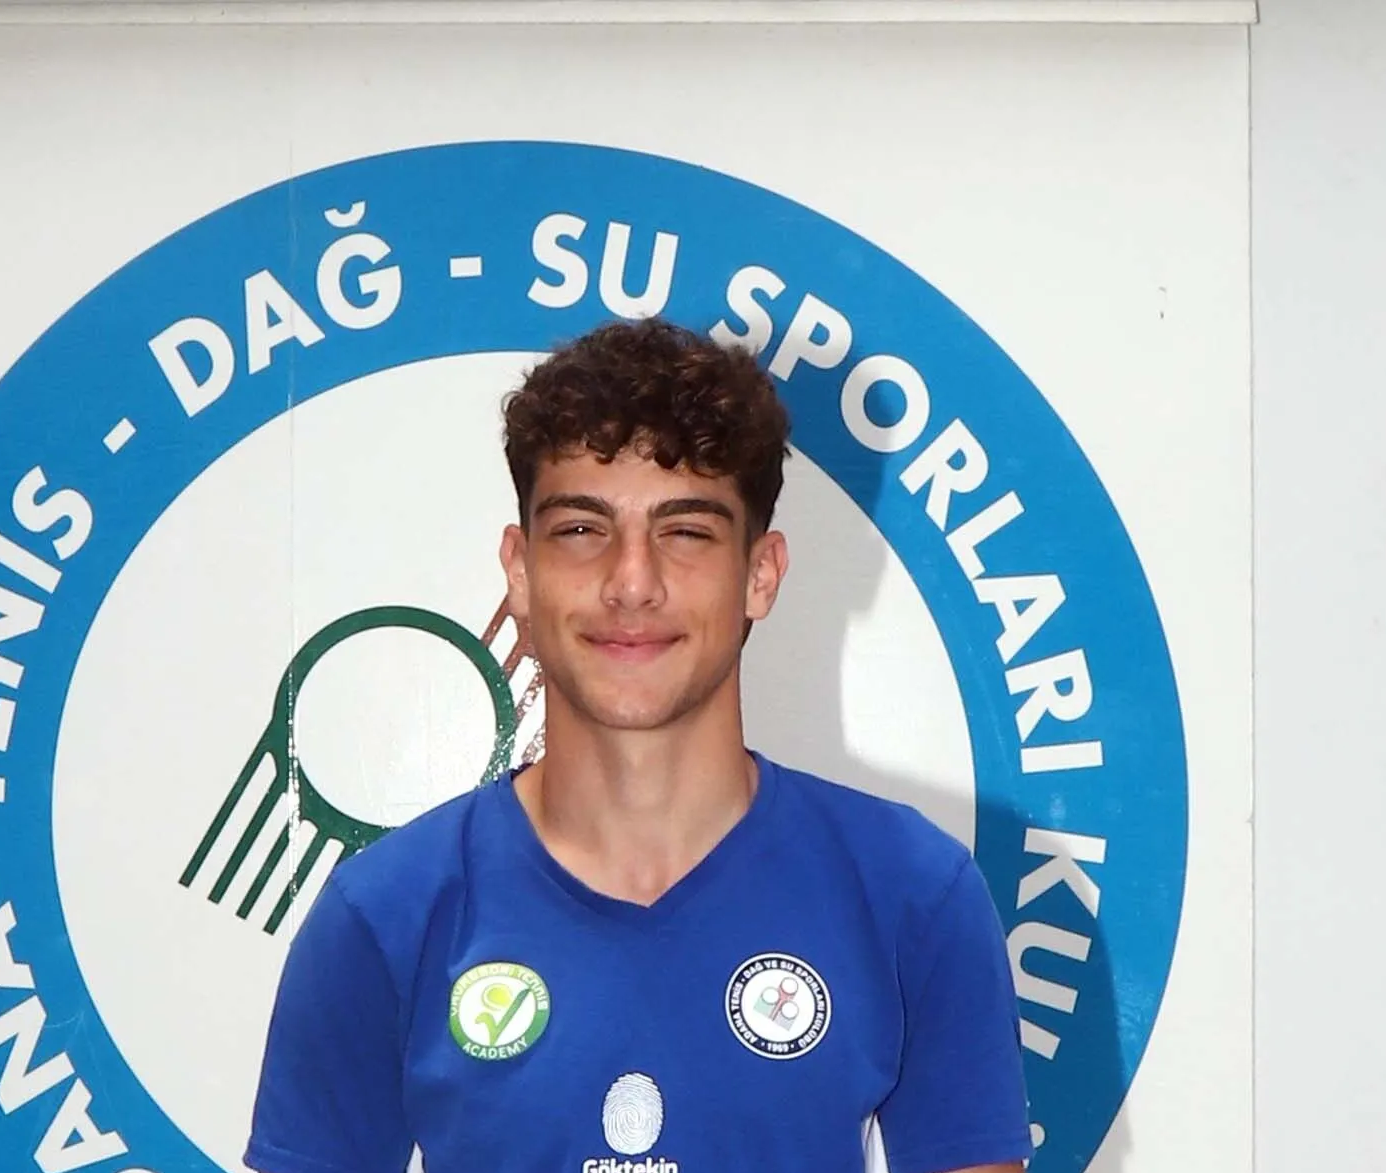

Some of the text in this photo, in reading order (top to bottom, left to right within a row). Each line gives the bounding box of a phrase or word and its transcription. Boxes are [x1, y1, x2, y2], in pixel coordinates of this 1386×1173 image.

[148, 200, 403, 417] DAĞ
[527, 212, 679, 322] SU
[708, 265, 1103, 774] SPORLARI
[763, 960, 778, 969] VE
[779, 960, 795, 971] SU
[462, 1036, 528, 1059] ACADEMY
